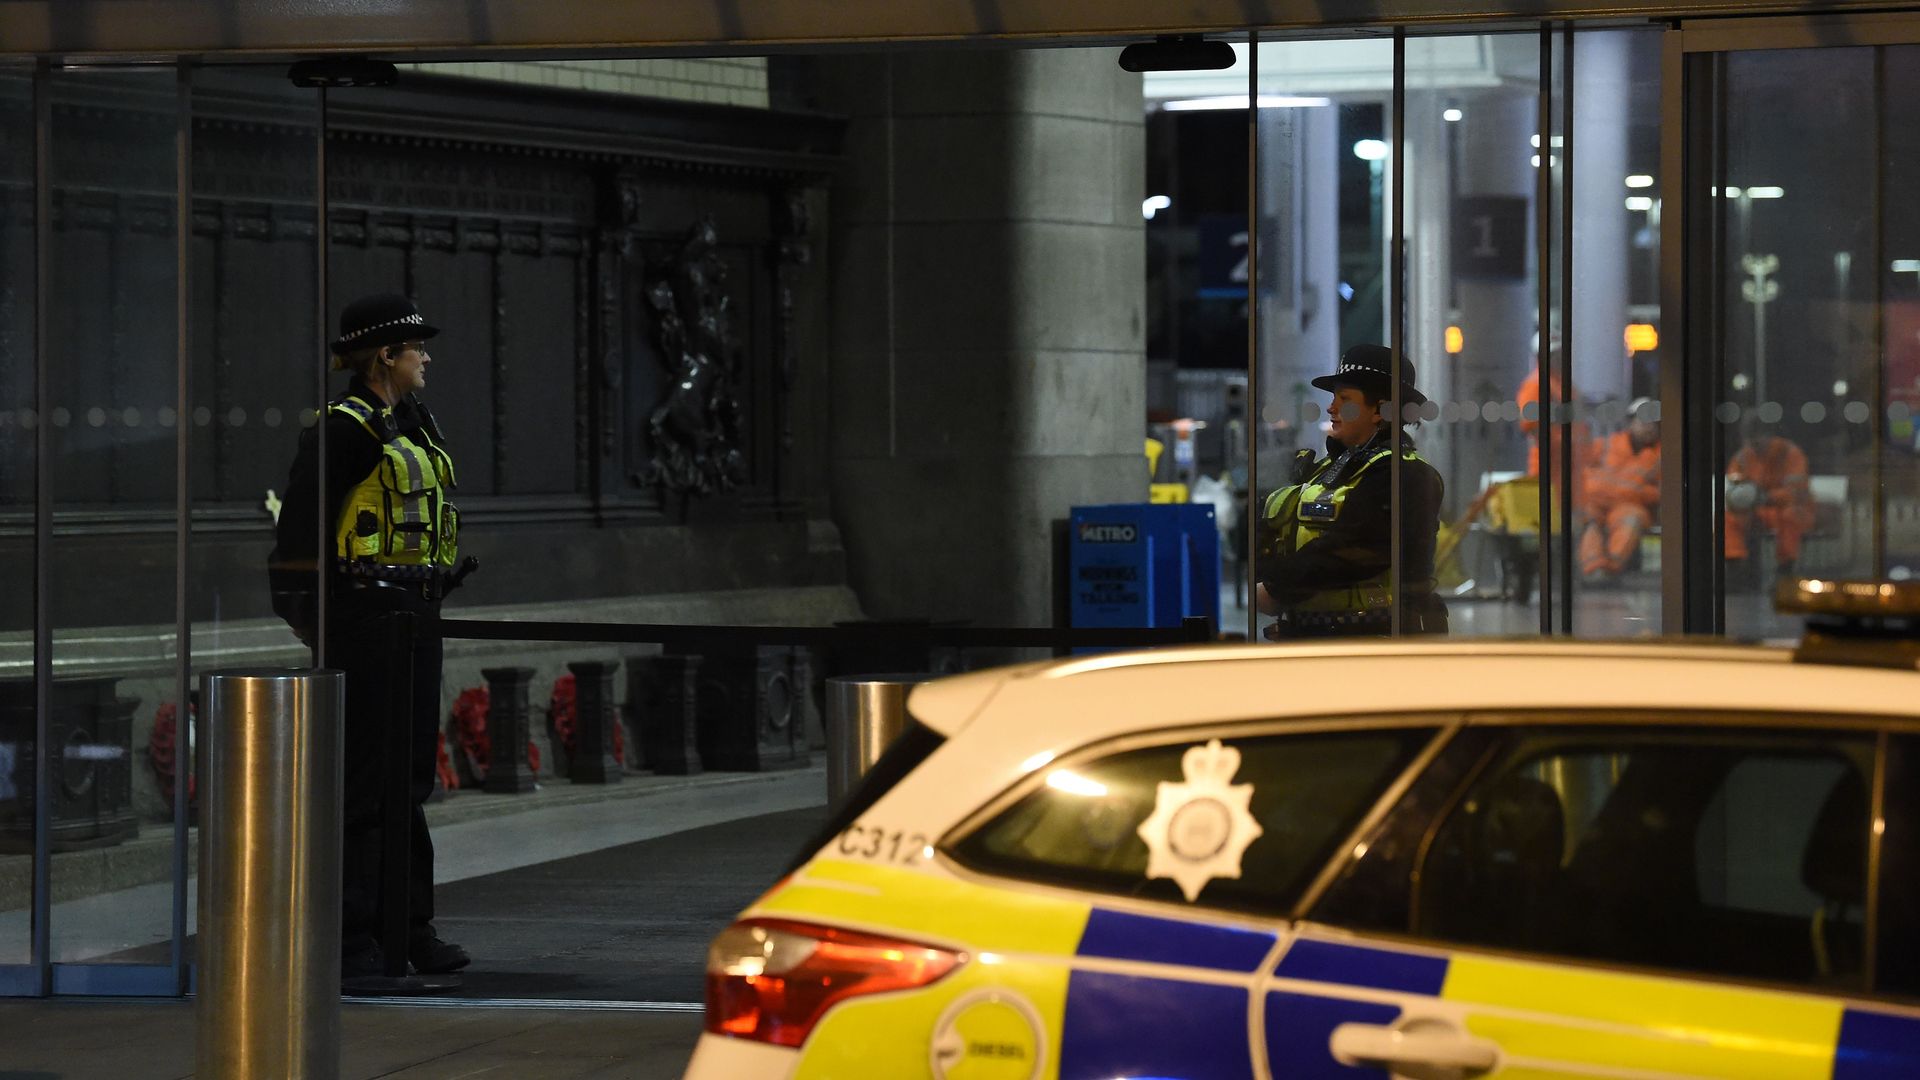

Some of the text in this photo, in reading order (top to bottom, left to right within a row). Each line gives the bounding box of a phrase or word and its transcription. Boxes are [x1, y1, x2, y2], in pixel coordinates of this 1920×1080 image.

[1228, 230, 1262, 282] 2
[1472, 215, 1500, 257] 1
[1080, 526, 1136, 541] METRO
[839, 823, 926, 864] C312
